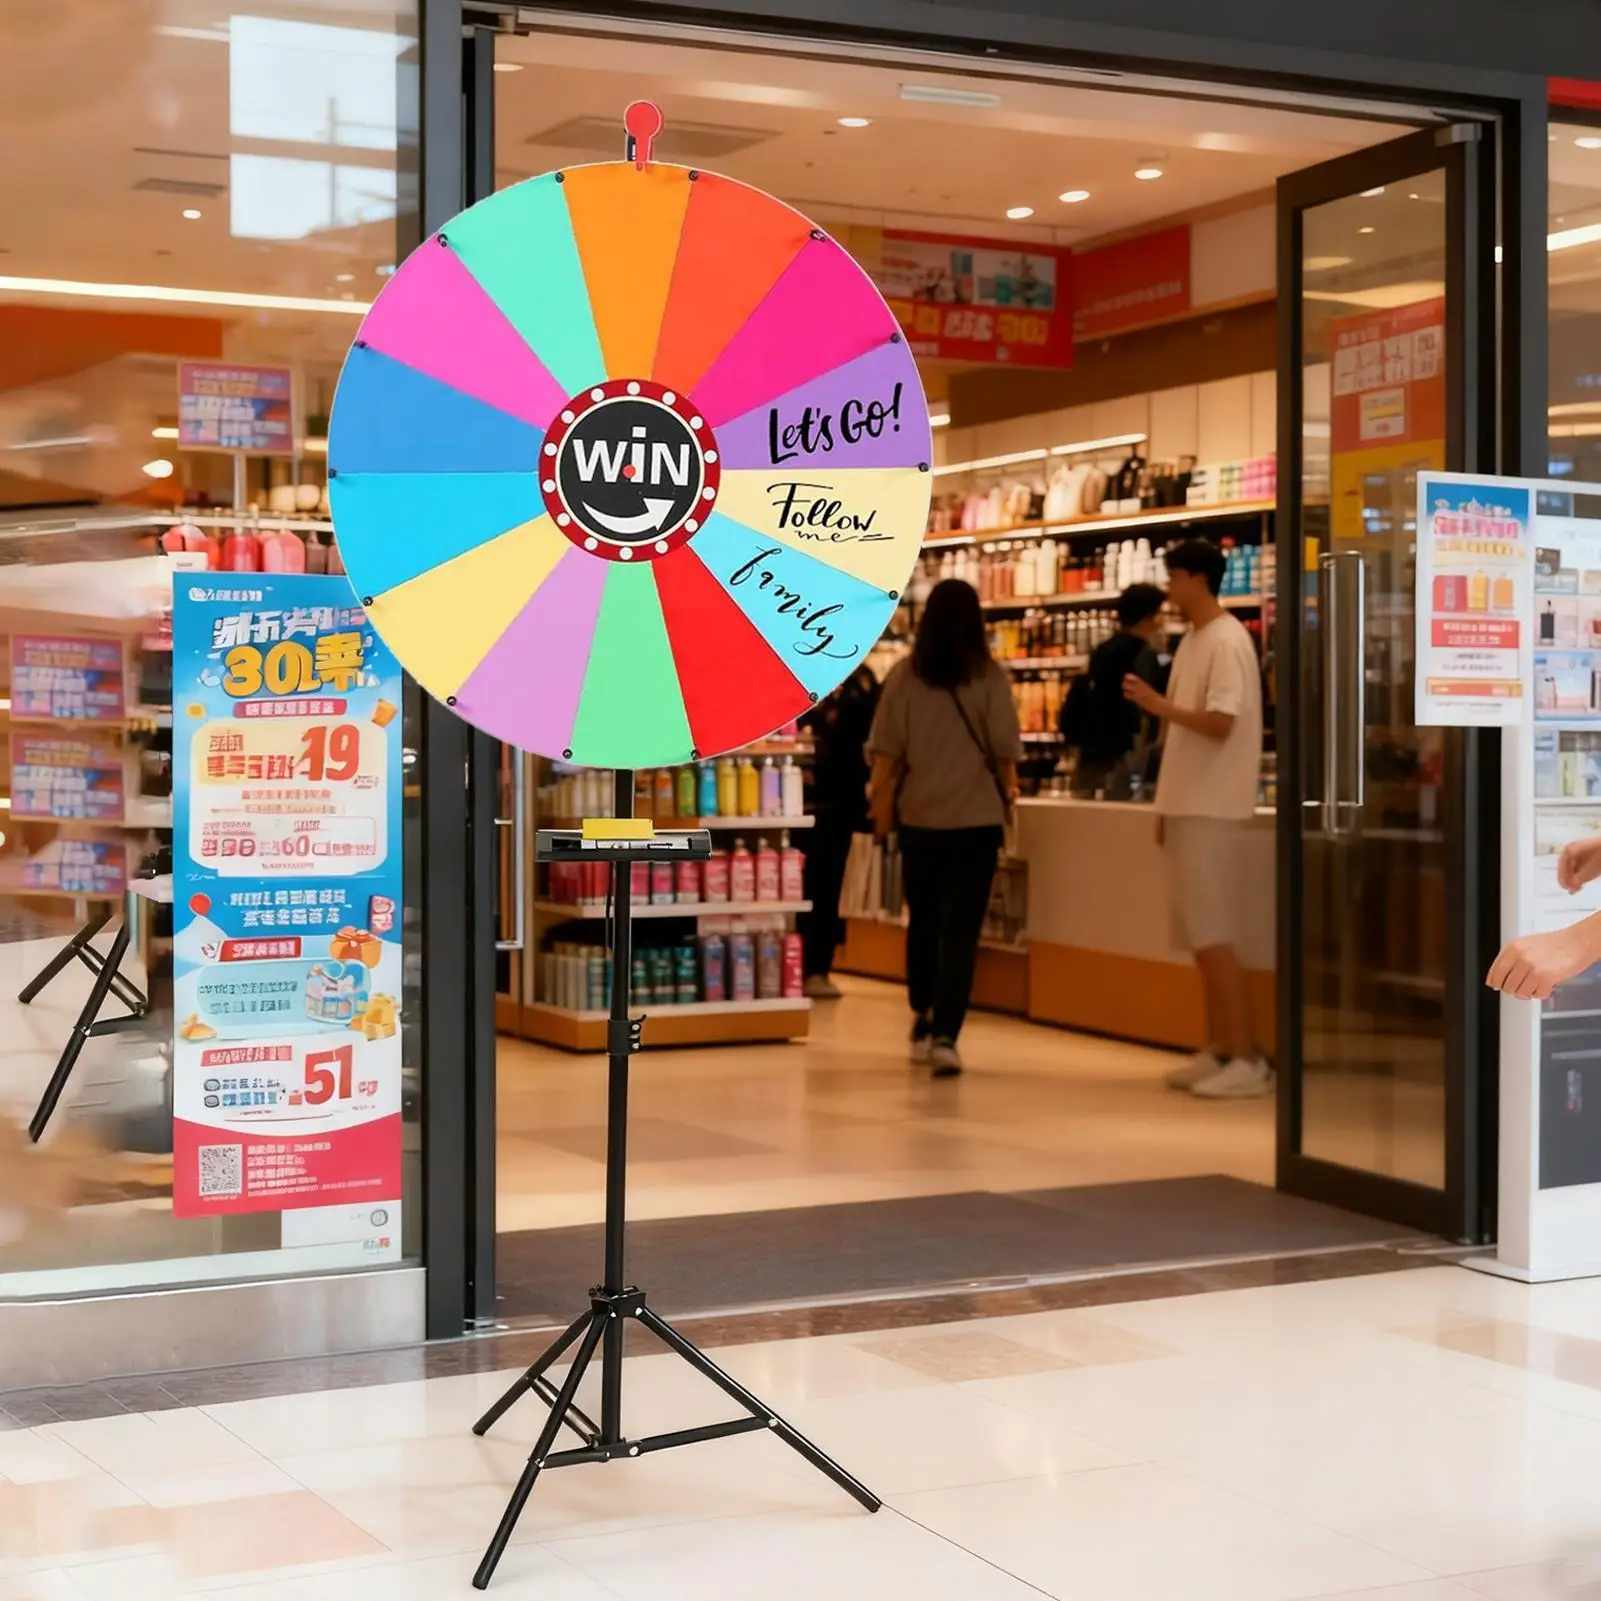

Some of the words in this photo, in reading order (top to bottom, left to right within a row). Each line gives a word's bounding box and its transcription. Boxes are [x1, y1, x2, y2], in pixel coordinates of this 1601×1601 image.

[768, 407, 834, 464] Let's
[766, 482, 877, 529] Follow
[729, 546, 858, 659] family
[301, 724, 360, 781] 19
